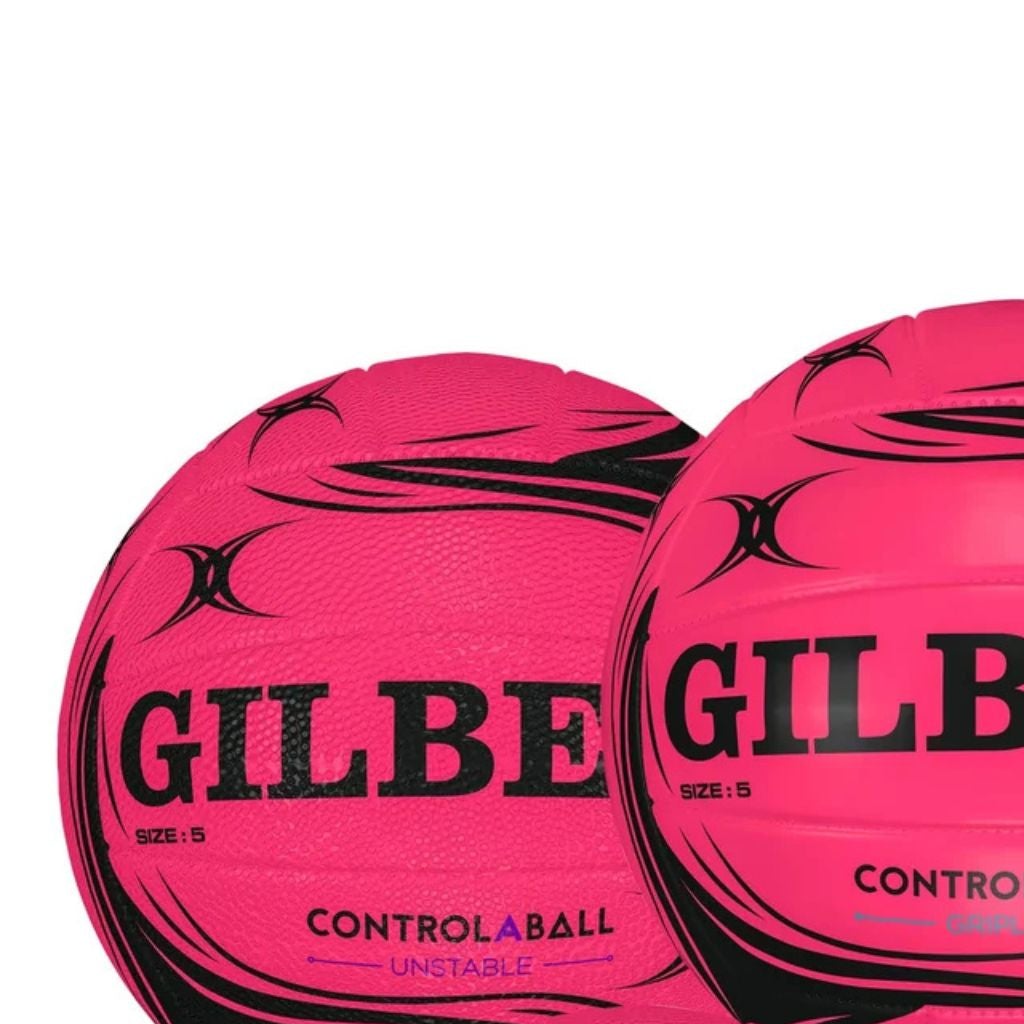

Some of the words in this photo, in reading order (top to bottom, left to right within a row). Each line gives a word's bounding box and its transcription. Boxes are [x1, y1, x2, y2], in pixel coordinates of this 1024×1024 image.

[735, 781, 752, 798] 5
[190, 826, 206, 844] 5
[390, 956, 533, 978] UNSTABLE
